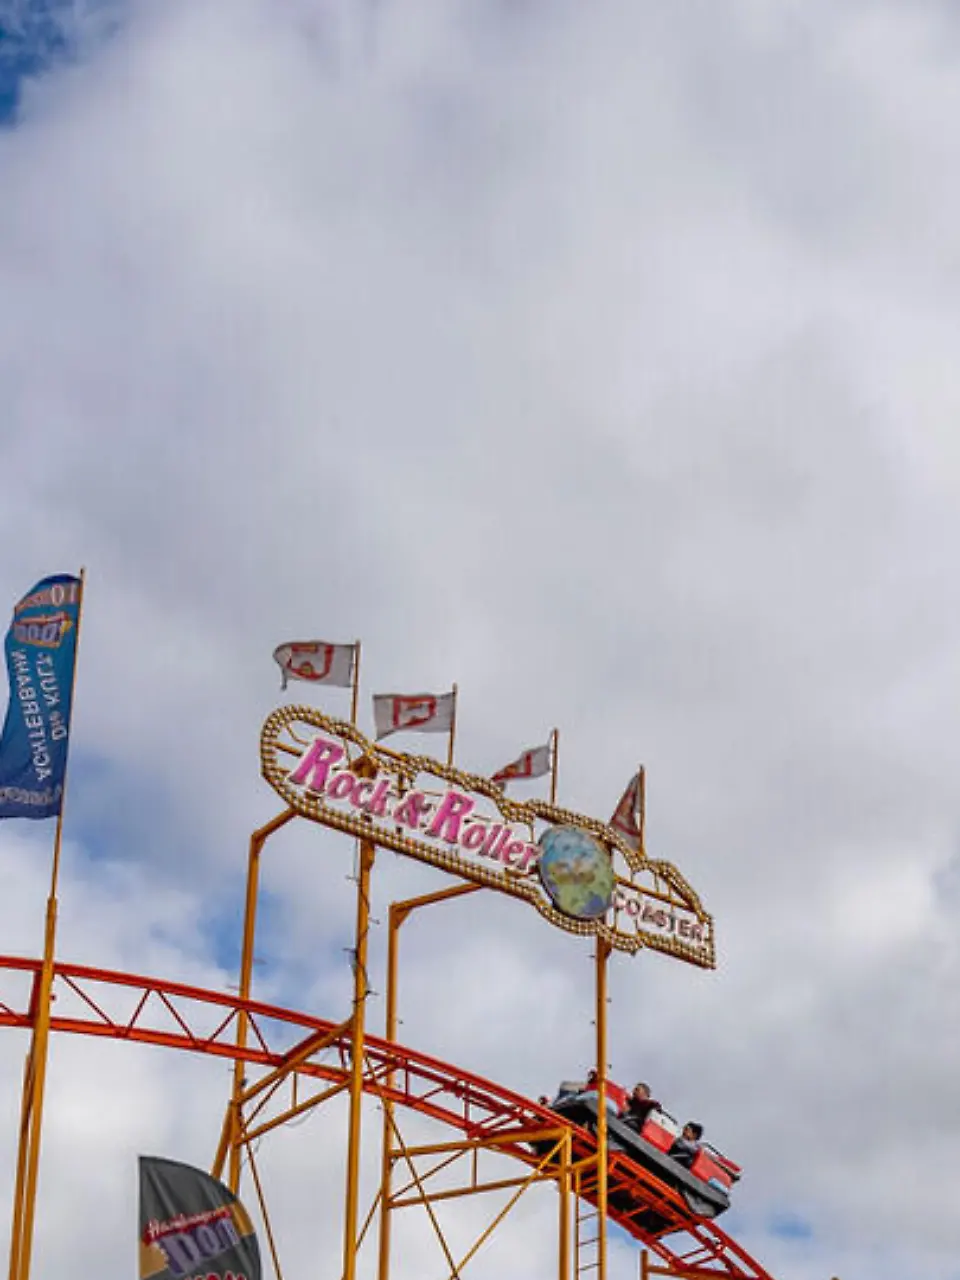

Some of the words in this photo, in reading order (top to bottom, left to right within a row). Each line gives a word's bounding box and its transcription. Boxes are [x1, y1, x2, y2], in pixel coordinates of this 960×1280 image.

[287, 737, 390, 817] Rock
[393, 789, 432, 829] &
[425, 790, 538, 870] Roller
